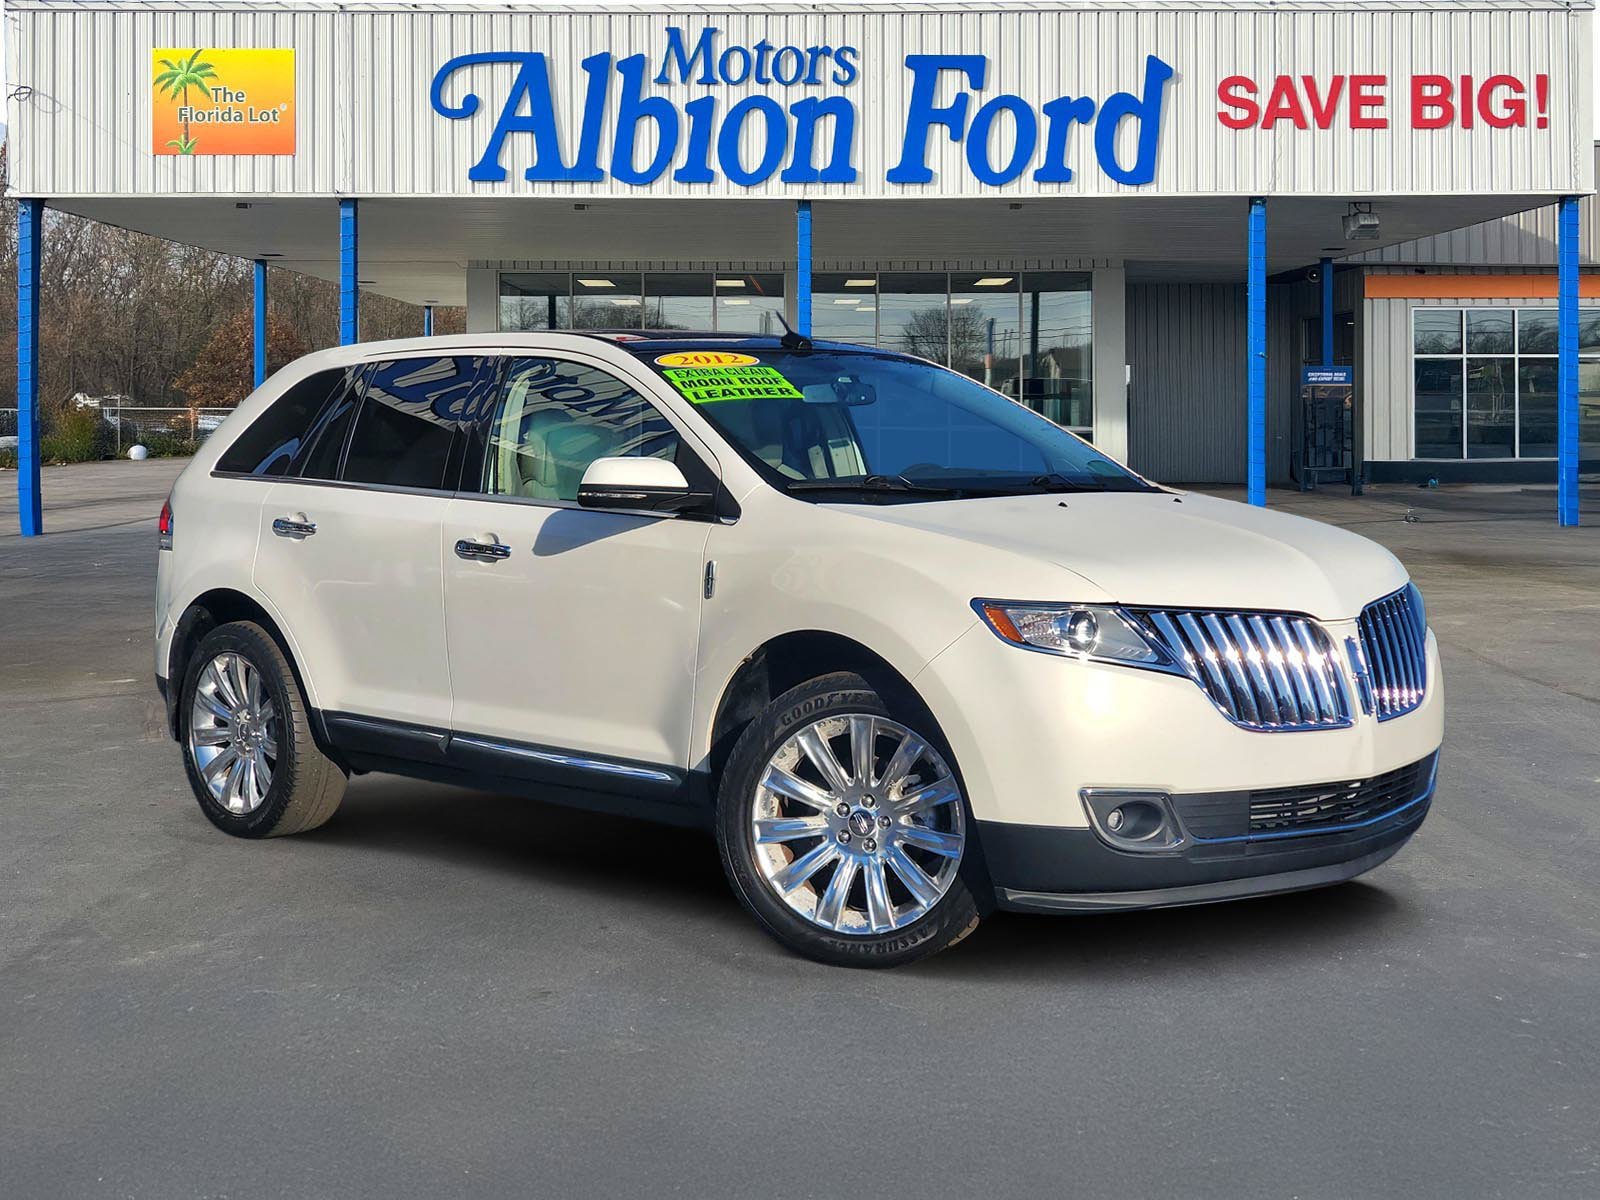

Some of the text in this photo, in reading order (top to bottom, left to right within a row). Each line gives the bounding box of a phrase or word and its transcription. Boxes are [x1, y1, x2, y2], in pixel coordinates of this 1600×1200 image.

[655, 27, 857, 86] Motors
[211, 86, 245, 103] The
[1217, 74, 1549, 130] SAVE BIG!
[177, 106, 279, 123] Florida Lot
[430, 51, 1176, 187] Albion Ford
[673, 354, 744, 366] 2012
[673, 367, 770, 378] EXTRA CLEAN
[680, 377, 781, 389] MOON ROOF
[692, 387, 793, 400] LEATHER
